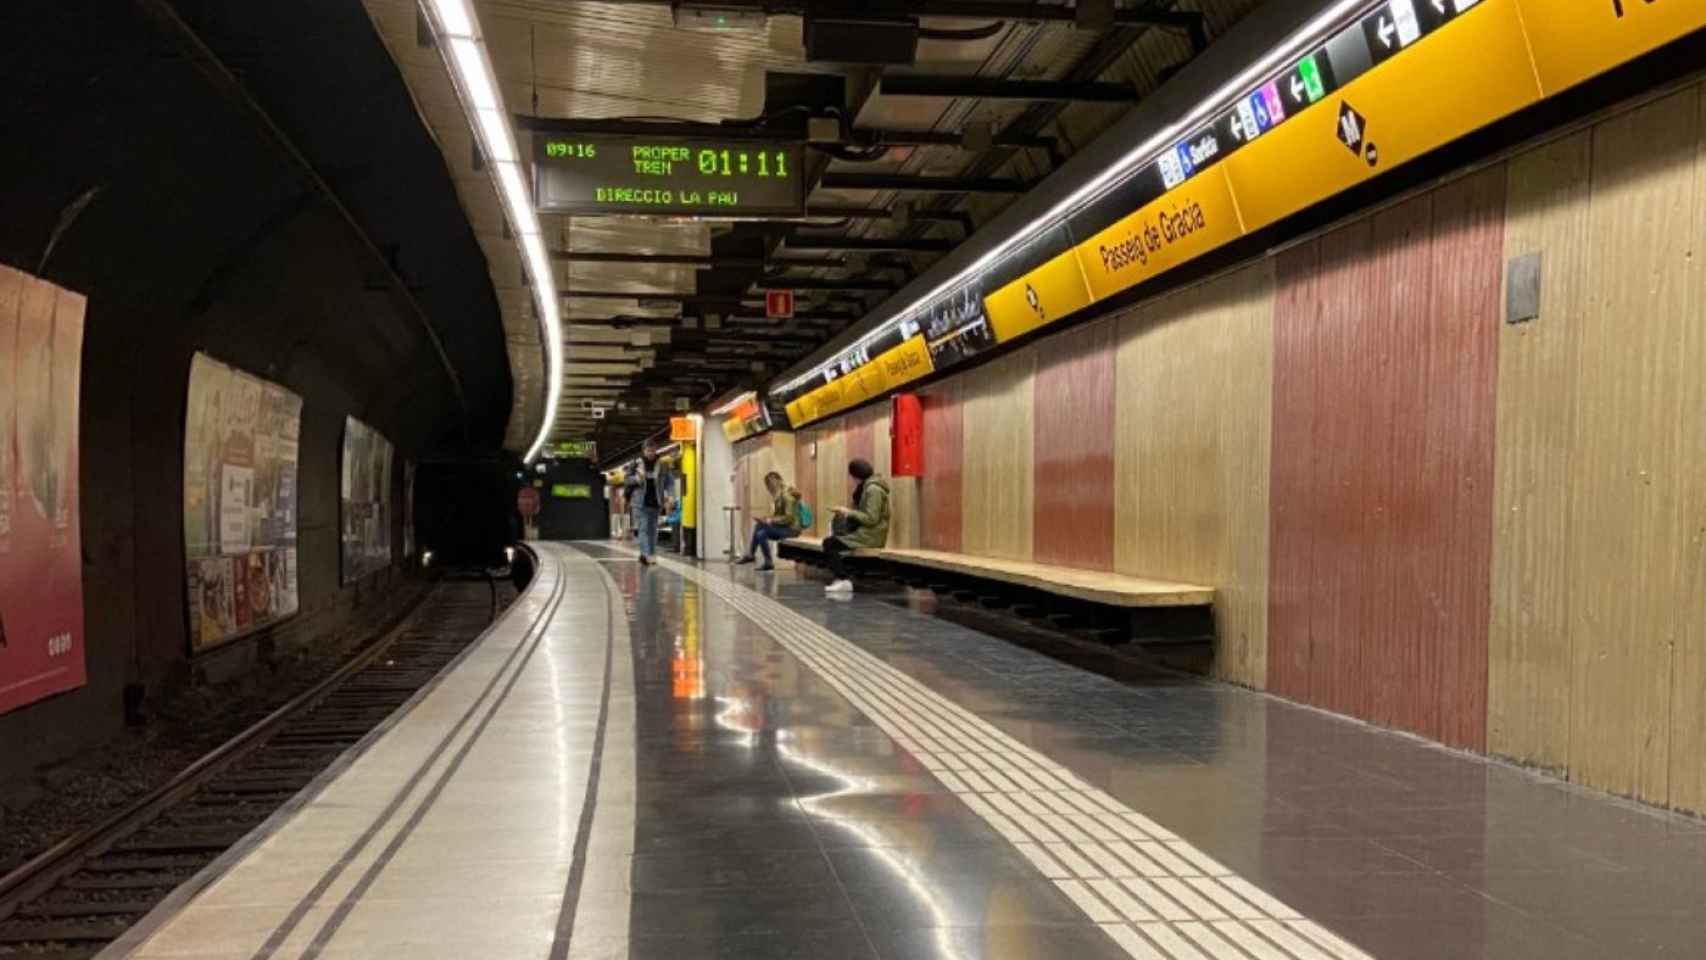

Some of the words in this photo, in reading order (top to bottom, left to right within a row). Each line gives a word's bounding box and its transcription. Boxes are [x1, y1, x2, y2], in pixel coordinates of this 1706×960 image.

[546, 143, 596, 158] 09:16
[632, 146, 690, 160] PROPER
[633, 160, 672, 175] TREN
[699, 149, 788, 177] 01:11
[596, 188, 672, 204] DIRECCIO
[679, 189, 701, 204] LA
[708, 190, 738, 205] PAU
[1100, 230, 1147, 275] Passeig
[1143, 221, 1161, 253] de
[1160, 197, 1206, 244] Gràcia
